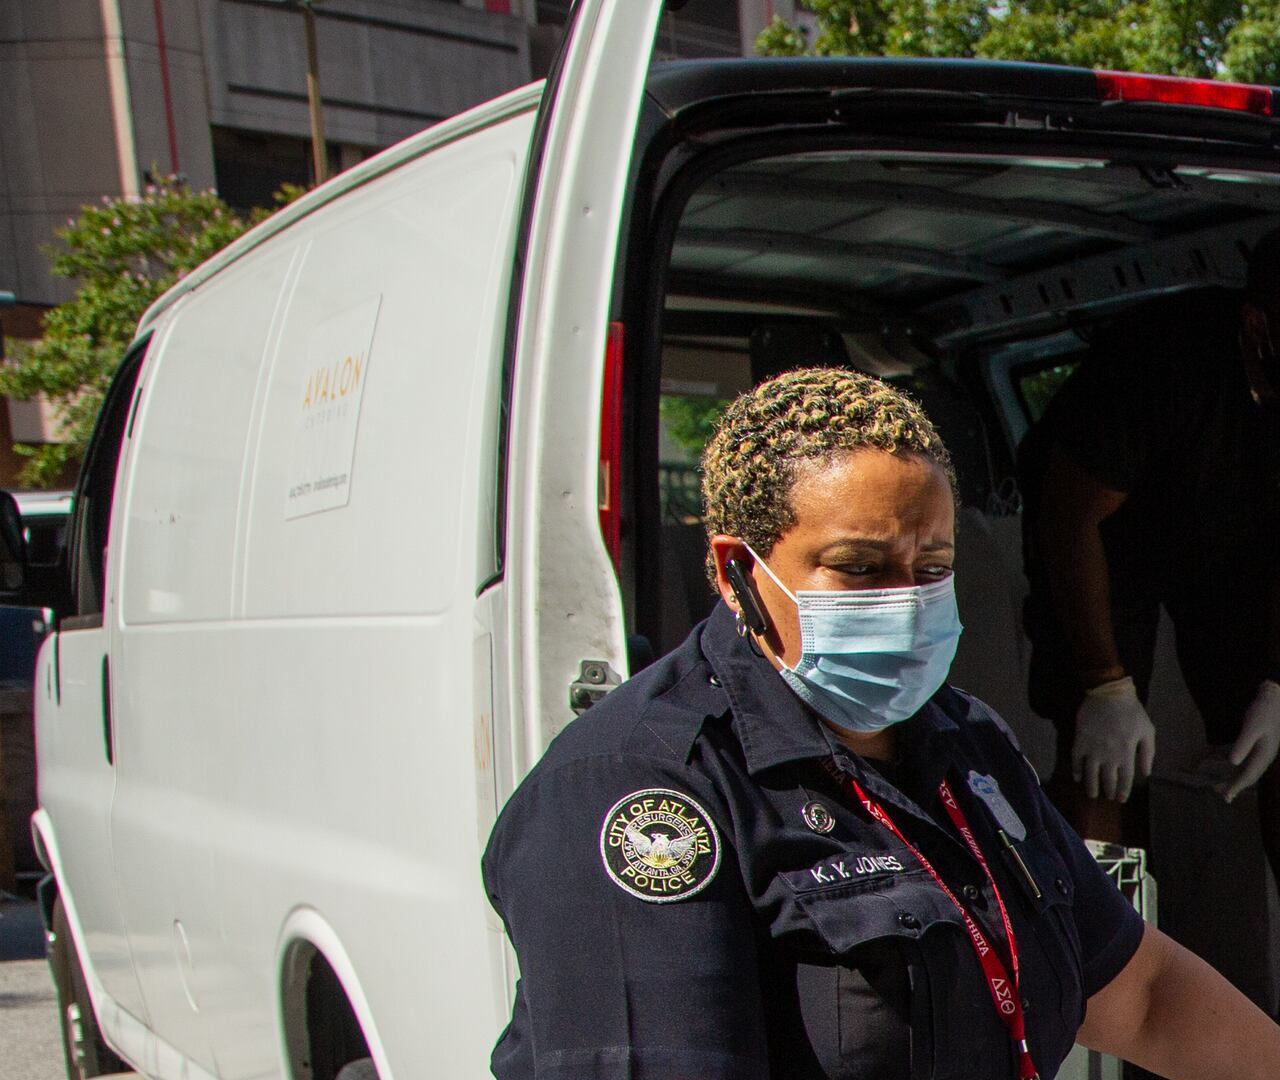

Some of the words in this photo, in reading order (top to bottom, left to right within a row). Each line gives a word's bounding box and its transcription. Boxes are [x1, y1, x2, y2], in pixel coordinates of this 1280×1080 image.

[302, 351, 365, 411] AVALON
[609, 813, 630, 847] CITY
[630, 799, 655, 816] OF
[658, 799, 711, 854] ATLANTA
[632, 813, 692, 837] RESURGENS
[620, 865, 697, 892] POLICE
[855, 856, 904, 875] JONES
[964, 915, 990, 957] THETA
